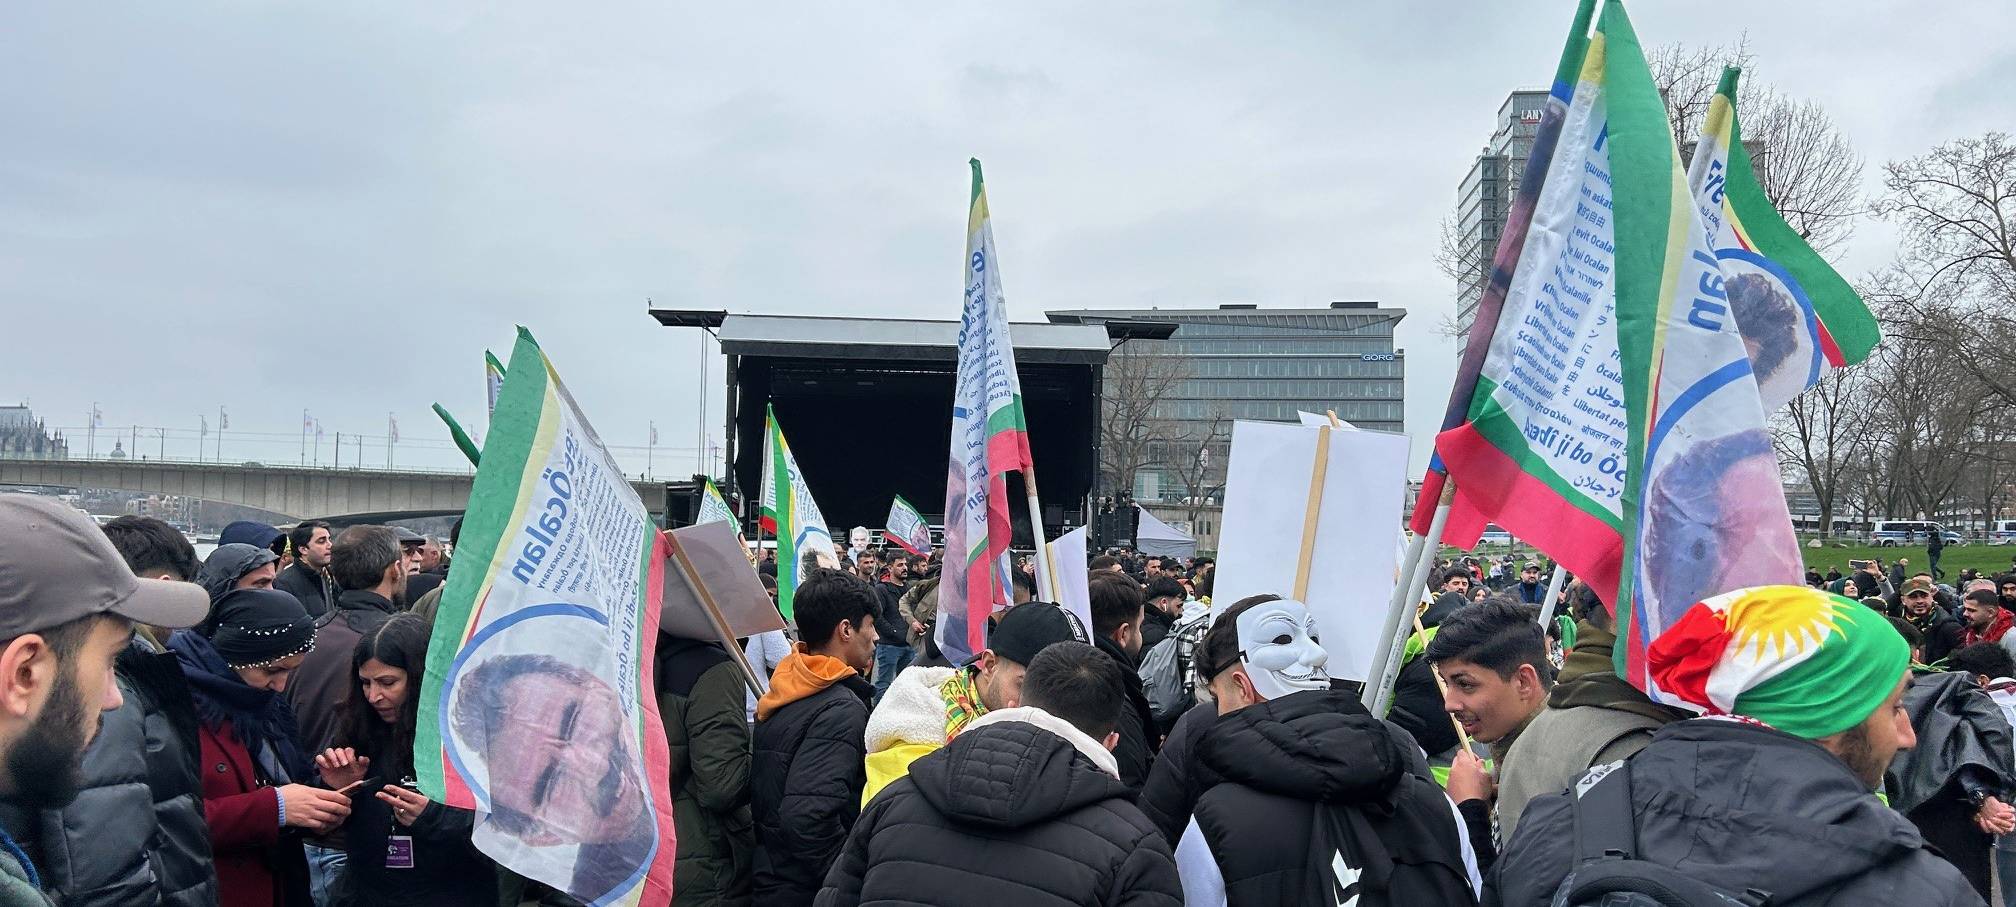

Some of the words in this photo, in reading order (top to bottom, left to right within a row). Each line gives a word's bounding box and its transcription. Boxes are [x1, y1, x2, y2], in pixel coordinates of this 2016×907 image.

[1592, 192, 1613, 211] askat
[1554, 434, 1573, 458] ji
[1569, 442, 1592, 464] bo
